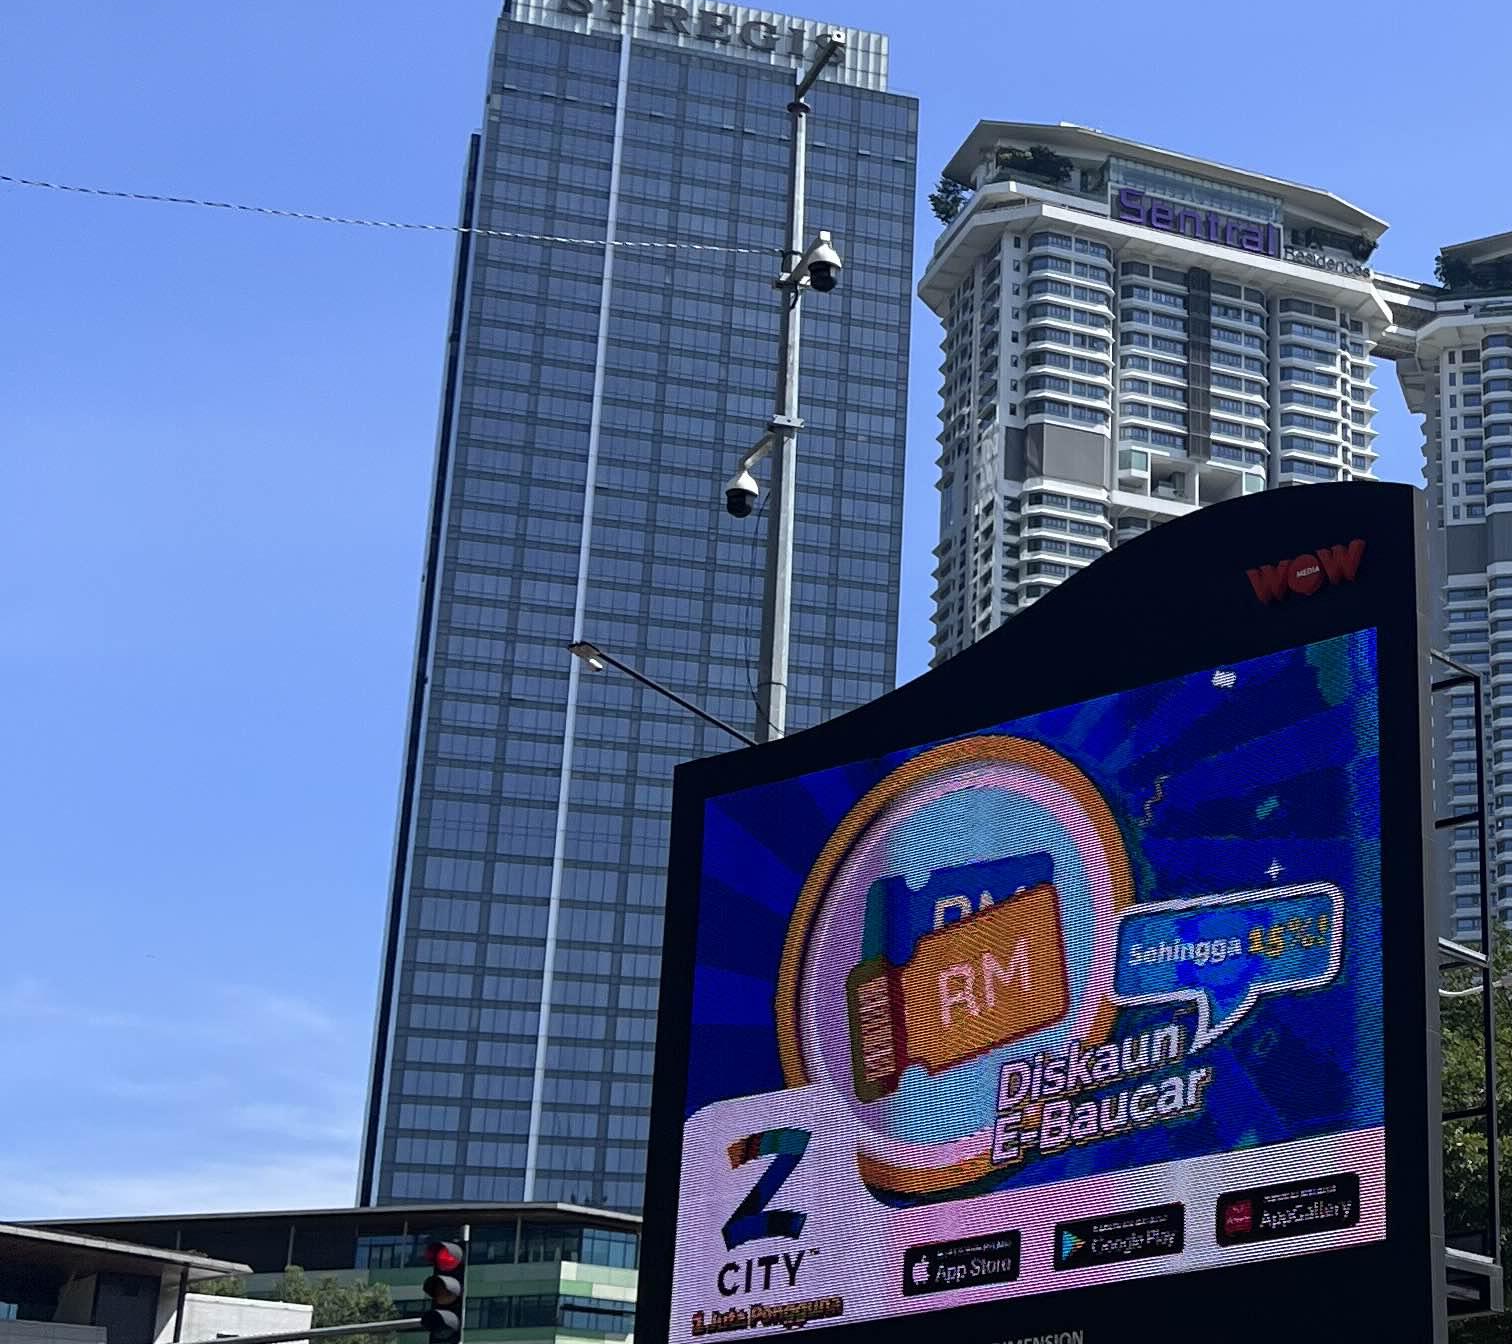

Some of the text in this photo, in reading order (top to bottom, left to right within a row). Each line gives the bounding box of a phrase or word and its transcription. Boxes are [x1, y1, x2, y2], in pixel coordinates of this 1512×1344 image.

[1118, 187, 1276, 256] Sentral
[1246, 539, 1366, 605] WOW
[1296, 565, 1320, 579] MEDIA
[938, 936, 1031, 1026] RM
[998, 1024, 1184, 1112] Diskaun
[992, 1067, 1211, 1164] E-Baucar
[935, 1257, 1012, 1285] App Store
